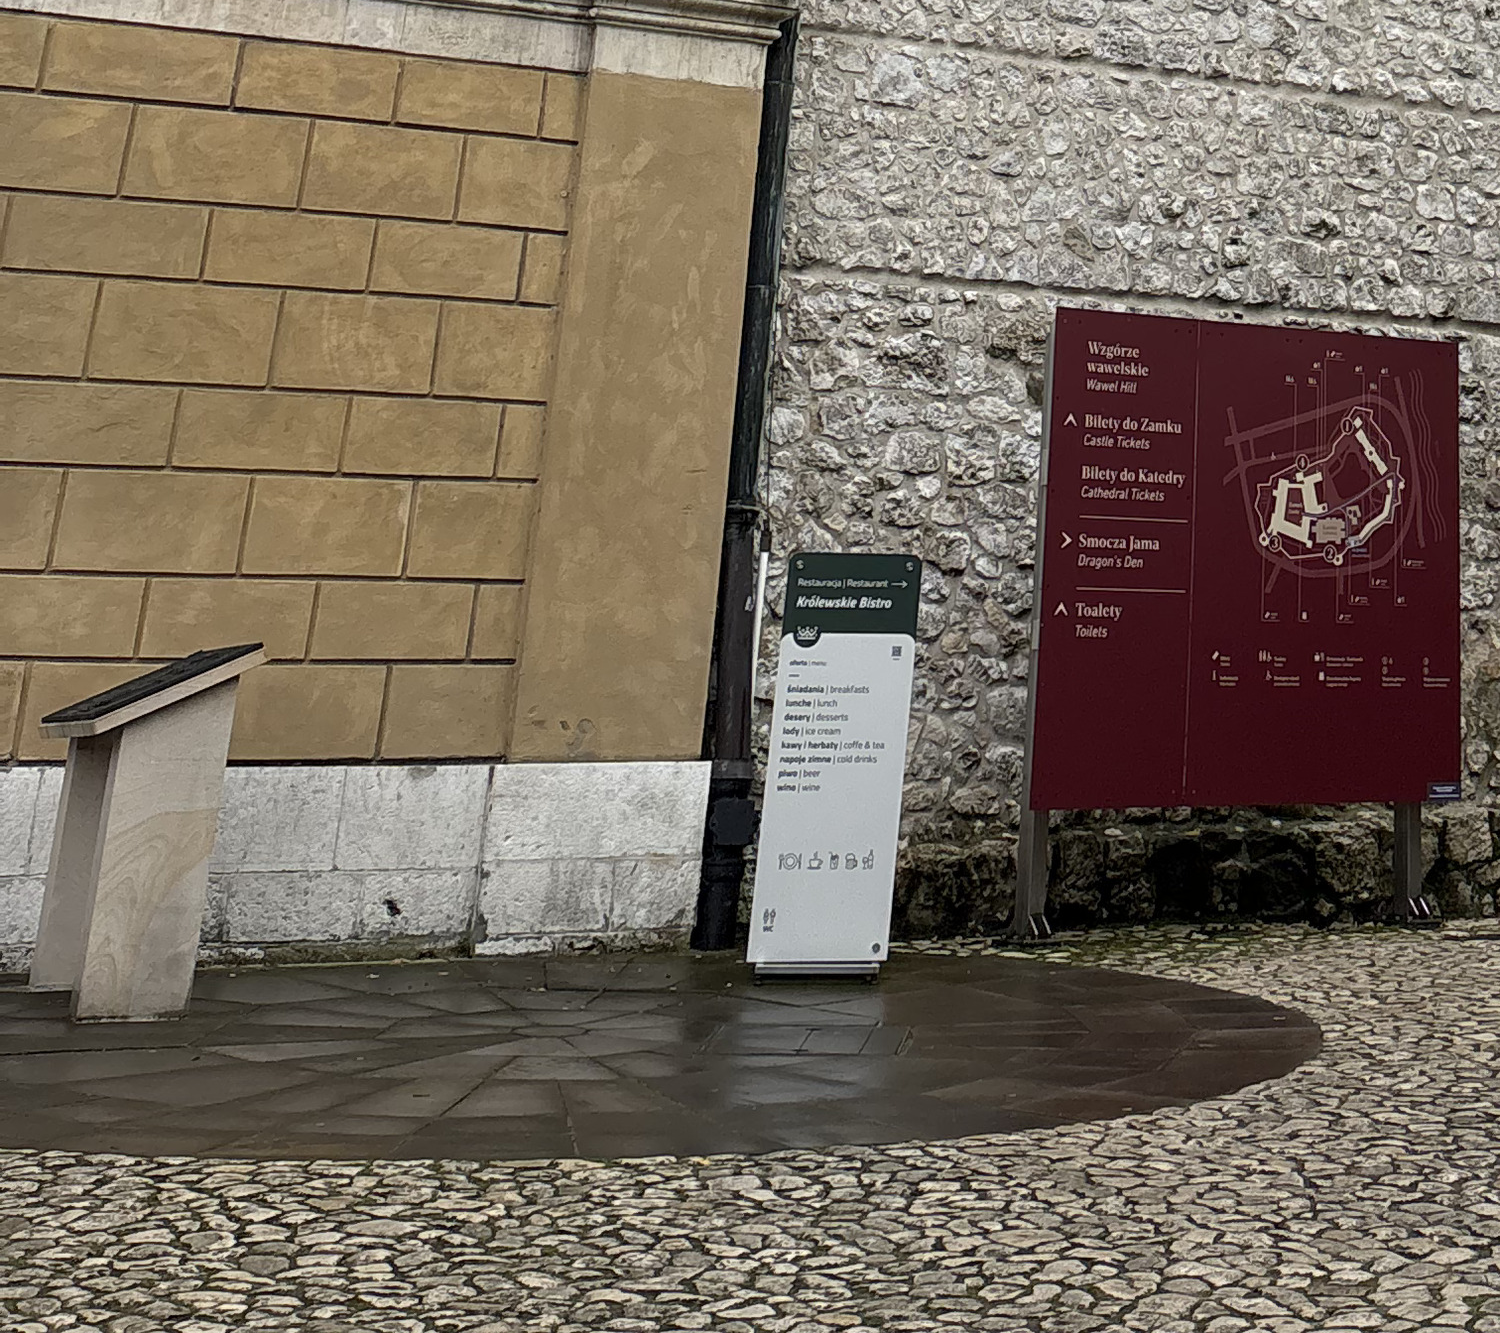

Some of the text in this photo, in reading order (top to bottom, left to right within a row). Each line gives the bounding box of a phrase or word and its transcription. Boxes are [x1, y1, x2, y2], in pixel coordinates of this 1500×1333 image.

[1087, 340, 1140, 359] Wzgórze
[1086, 361, 1150, 377] wawelskie
[1086, 378, 1137, 394] Wawel Hill
[1084, 413, 1183, 434] Bilety do Zamku
[1083, 434, 1151, 450] Castle Tickets
[1081, 465, 1186, 488] Bilety do Katedry
[1080, 485, 1165, 502] Cathedral Tickets
[1078, 533, 1160, 553] Smocza Jama
[1077, 553, 1144, 569] Dragon's Den
[846, 578, 889, 588] Restaurant
[796, 595, 893, 609] Królewskie Bistro
[1075, 602, 1123, 621] Toalety
[1075, 624, 1109, 638] Toilets
[829, 685, 870, 694] breakfasts
[817, 699, 838, 708] lunch
[784, 713, 849, 723] desery desserts
[782, 726, 841, 737] lody ice cream
[781, 741, 803, 751] kawy
[808, 741, 839, 751] herbaty
[843, 741, 863, 750] coffe
[872, 741, 885, 750] tea
[837, 755, 853, 763] cold
[853, 755, 878, 763] drinks
[803, 769, 821, 778] beer
[801, 784, 821, 792] wine
